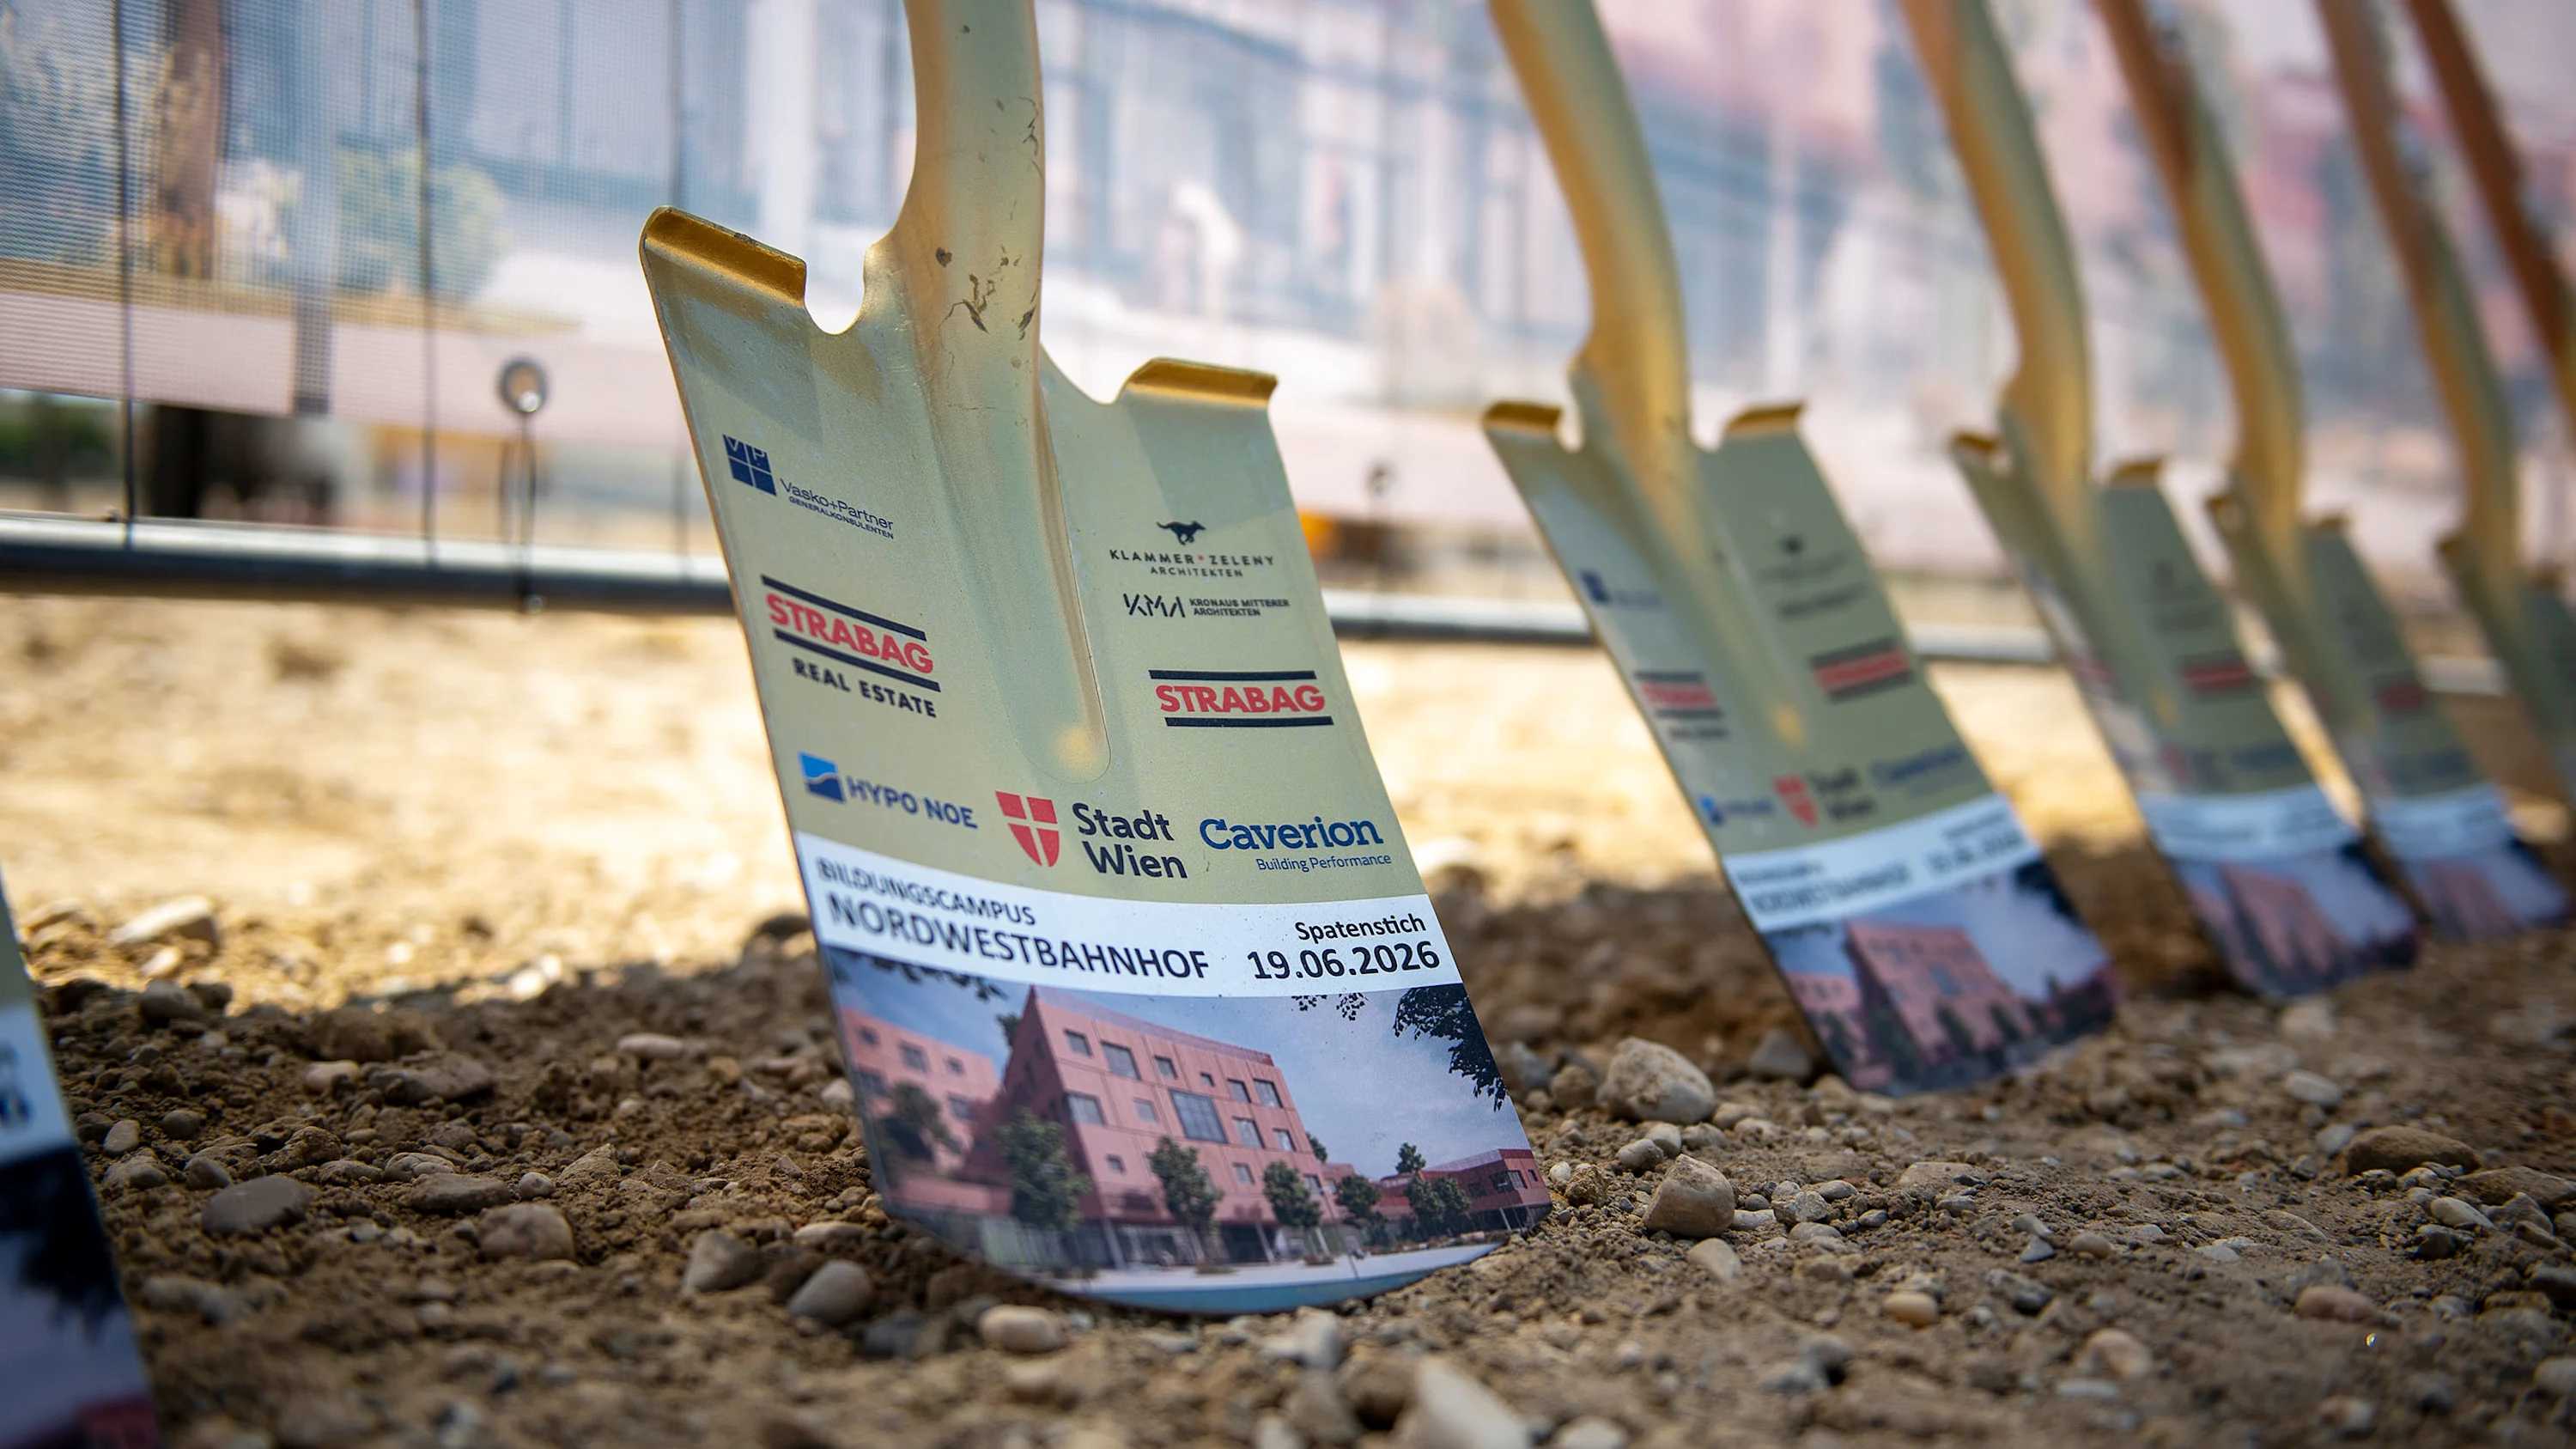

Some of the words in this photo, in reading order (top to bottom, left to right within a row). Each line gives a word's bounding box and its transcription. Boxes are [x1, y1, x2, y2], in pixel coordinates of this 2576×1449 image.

[780, 478, 894, 530] Vasko+Partner
[788, 496, 895, 539] GENERALKONSULENTEN
[1109, 549, 1194, 564] KLAMMER
[1209, 555, 1274, 566] ZELENY
[1150, 567, 1243, 578] ARCHITEKTEN
[1189, 598, 1239, 607] KRONAUS
[1241, 599, 1291, 607] MITTERER
[1193, 607, 1261, 616] ARCHITEKTEN
[765, 593, 933, 673] STRABAG
[792, 657, 851, 692] REAL
[860, 680, 937, 718] ESTATE
[1156, 685, 1326, 713] STRABAG
[846, 775, 919, 815] HYPO
[924, 796, 978, 830] NOE
[1072, 802, 1175, 841] Stadt
[1200, 815, 1383, 849] Caverion
[1082, 840, 1188, 879] Wien
[1256, 857, 1309, 873] Building
[1311, 853, 1391, 869] Performance
[817, 857, 1036, 926] BILDUNGSCAMPUS
[826, 891, 1209, 979] NORDWESTBAHNHOF
[1295, 913, 1426, 944] Spatenstich
[1248, 940, 1440, 980] 19.06.2026
